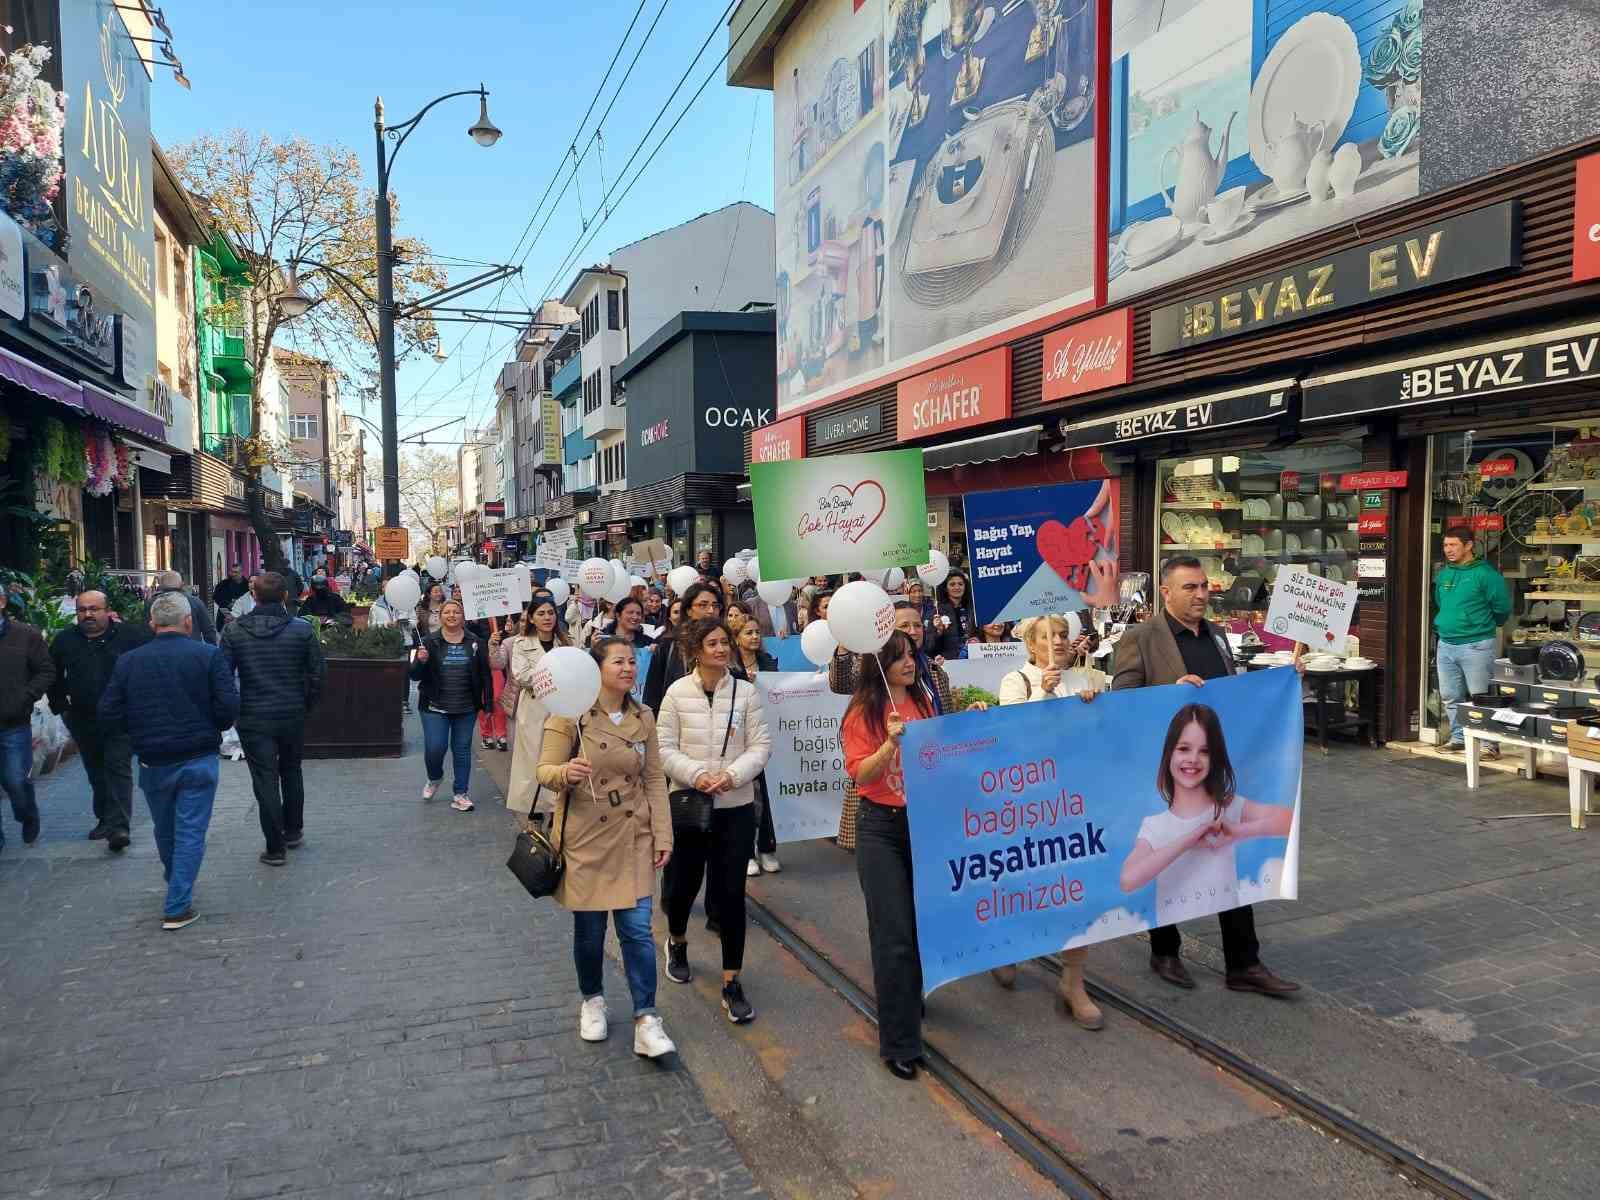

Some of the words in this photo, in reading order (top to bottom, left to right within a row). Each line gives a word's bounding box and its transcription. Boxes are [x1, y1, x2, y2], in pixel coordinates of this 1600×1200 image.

[75, 175, 117, 252] BEAUTY
[1193, 264, 1335, 337] BEYAZ
[1369, 231, 1444, 292] EV
[1411, 352, 1524, 398] BEYAZ
[1545, 338, 1600, 378] EV
[705, 407, 771, 427] OCAK
[912, 386, 982, 431] SCHAFER
[1121, 410, 1177, 437] BEYAZ
[1186, 402, 1213, 427] EV
[847, 415, 869, 433] HOME
[824, 511, 865, 543] Hayat
[973, 526, 1008, 542] Bağış
[1008, 524, 1035, 539] Yap,
[976, 544, 1013, 560] Hayat
[977, 561, 1023, 579] Kurtar!
[1283, 584, 1313, 600] ORGAN
[1305, 578, 1318, 589] DE
[779, 716, 802, 731] her
[805, 714, 839, 730] fidan
[800, 755, 828, 773] her
[979, 756, 1057, 794] organ
[779, 778, 828, 797] hayata
[964, 788, 1085, 839] bağışıyla
[948, 821, 1107, 893] yaşatmak
[975, 872, 1085, 923] elinizde
